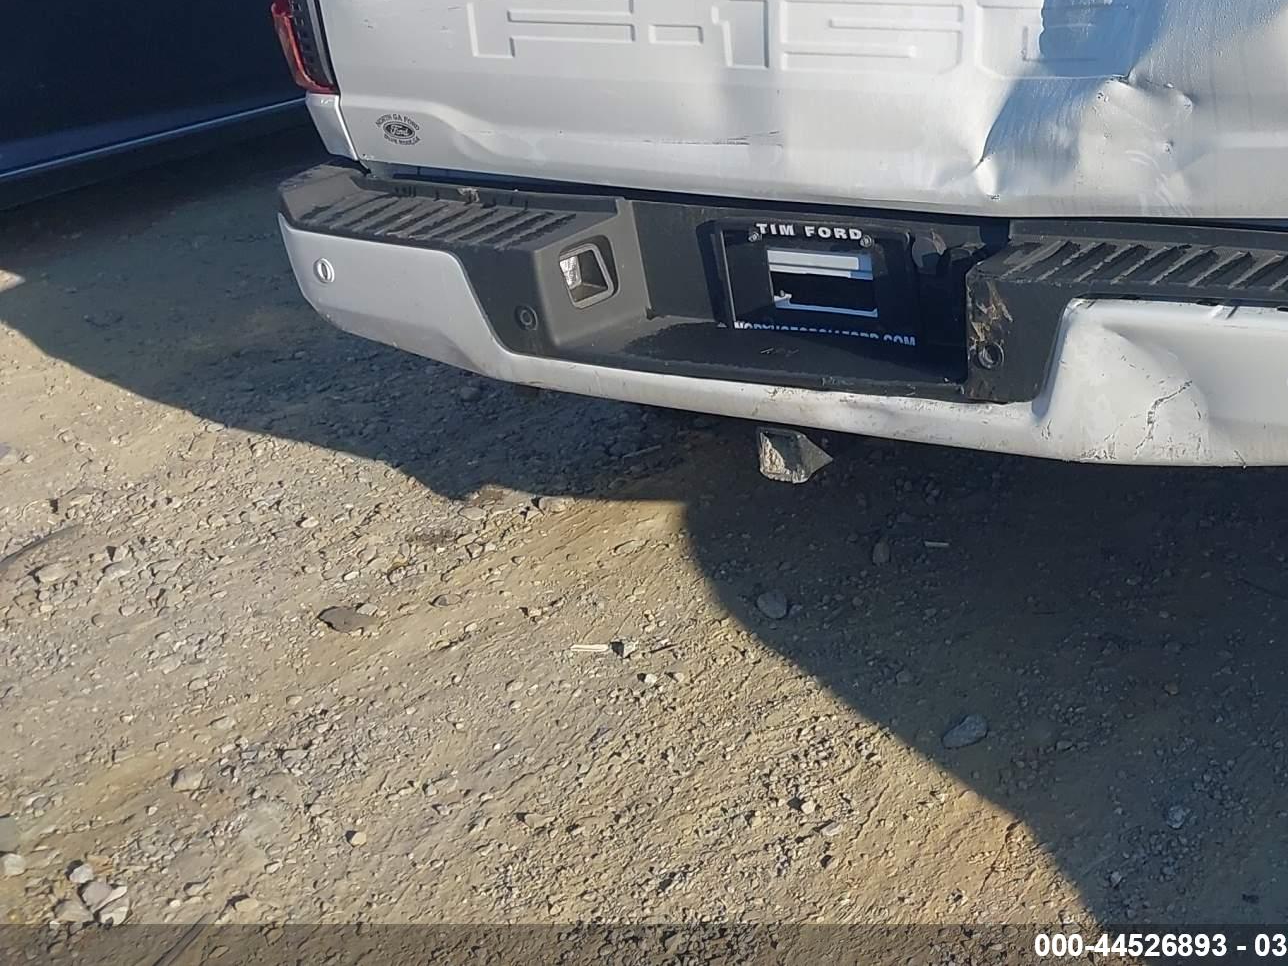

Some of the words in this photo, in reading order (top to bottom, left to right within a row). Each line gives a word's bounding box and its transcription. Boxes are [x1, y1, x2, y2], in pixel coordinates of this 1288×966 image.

[392, 113, 403, 122] GA
[756, 223, 795, 236] TIM
[804, 226, 863, 240] FORD
